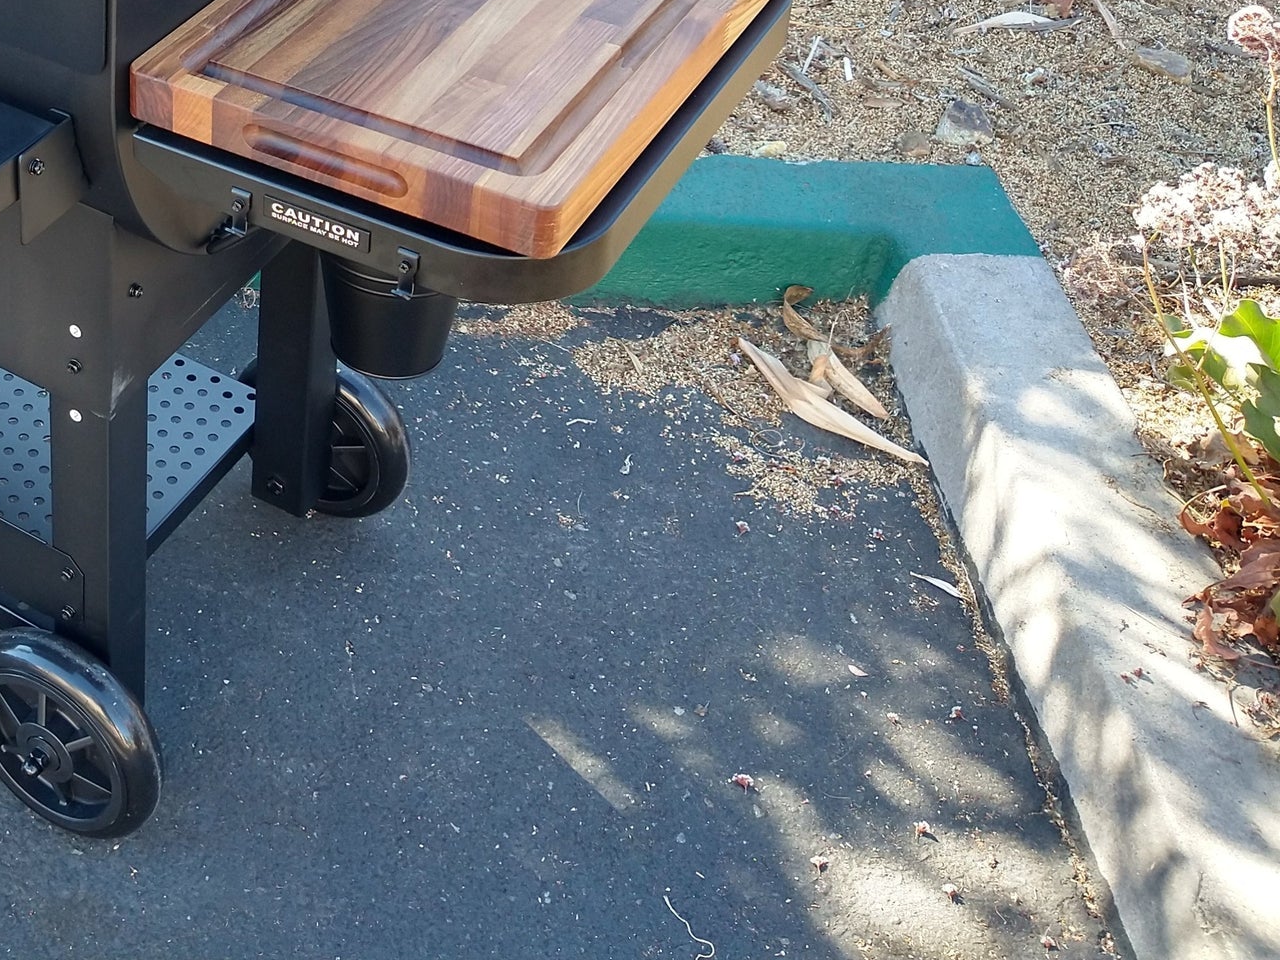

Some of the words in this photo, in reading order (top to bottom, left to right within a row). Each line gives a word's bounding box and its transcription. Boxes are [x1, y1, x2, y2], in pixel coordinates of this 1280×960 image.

[271, 202, 360, 242] CAUTION
[271, 211, 309, 230] SURFACE
[309, 226, 327, 237] MAY
[328, 232, 340, 241] BE
[341, 237, 359, 248] HOT
